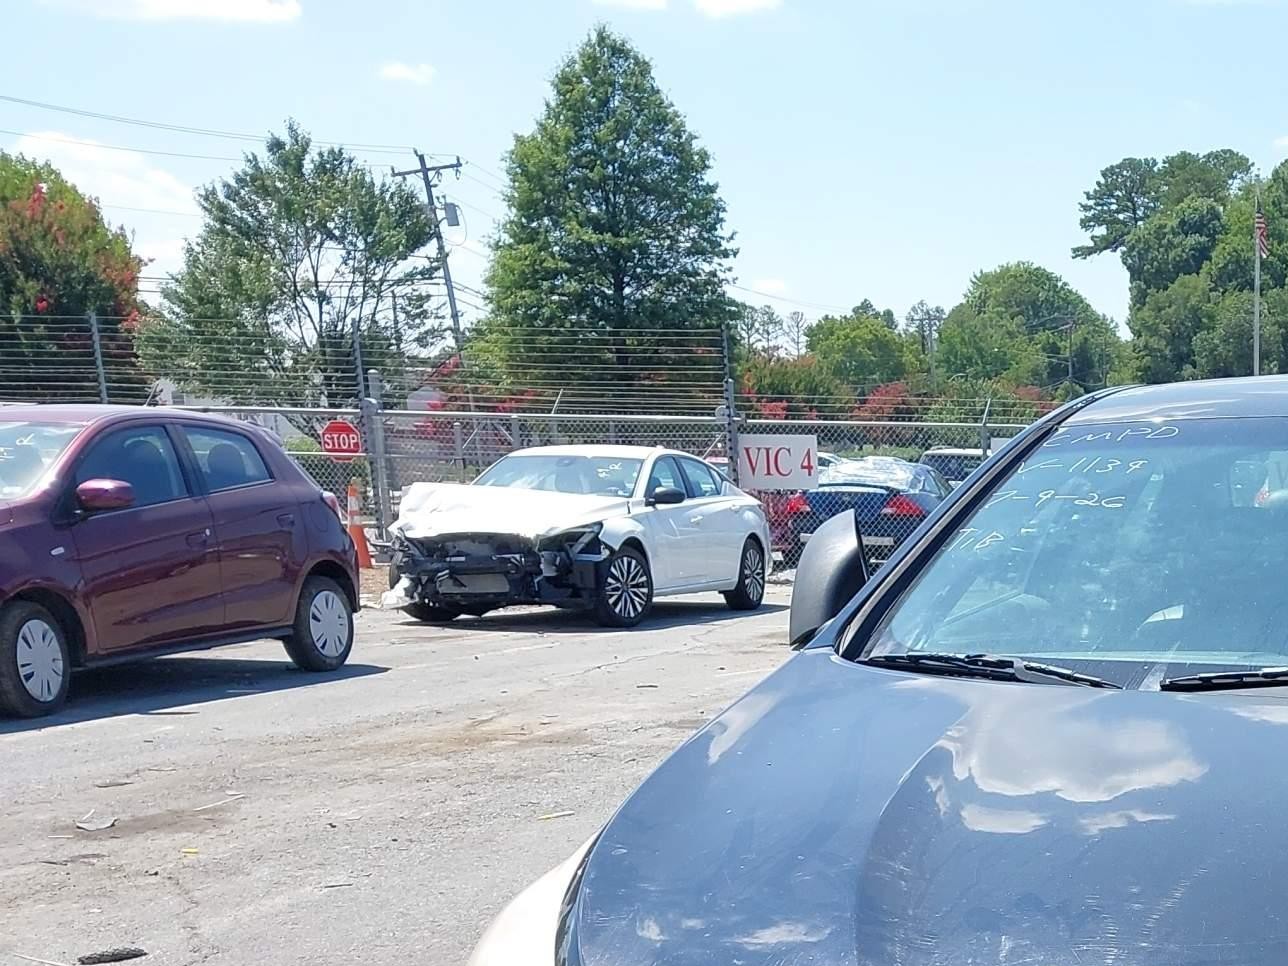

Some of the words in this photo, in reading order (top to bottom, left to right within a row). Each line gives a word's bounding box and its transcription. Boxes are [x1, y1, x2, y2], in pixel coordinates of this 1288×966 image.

[324, 433, 358, 449] STOP
[743, 446, 793, 477] VIC
[800, 447, 814, 477] 4
